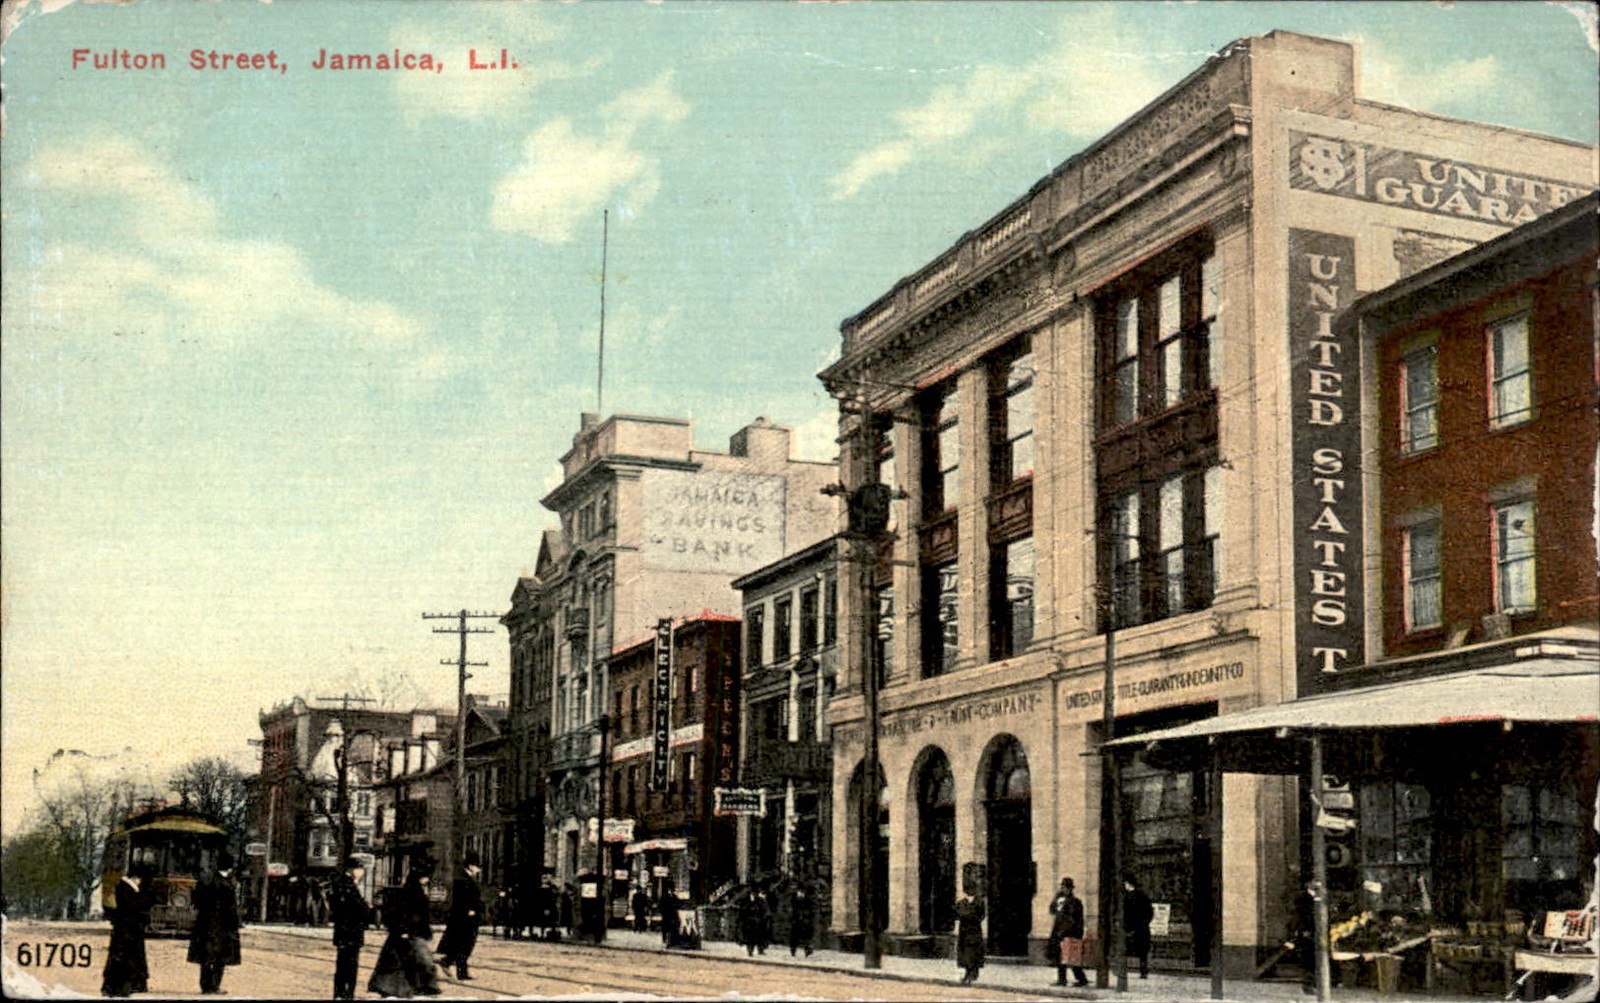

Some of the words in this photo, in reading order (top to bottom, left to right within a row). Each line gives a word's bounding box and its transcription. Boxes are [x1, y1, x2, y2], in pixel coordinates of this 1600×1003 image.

[1303, 252, 1344, 426] UNITED
[671, 536, 756, 557] BANK
[1309, 447, 1350, 627] STATES
